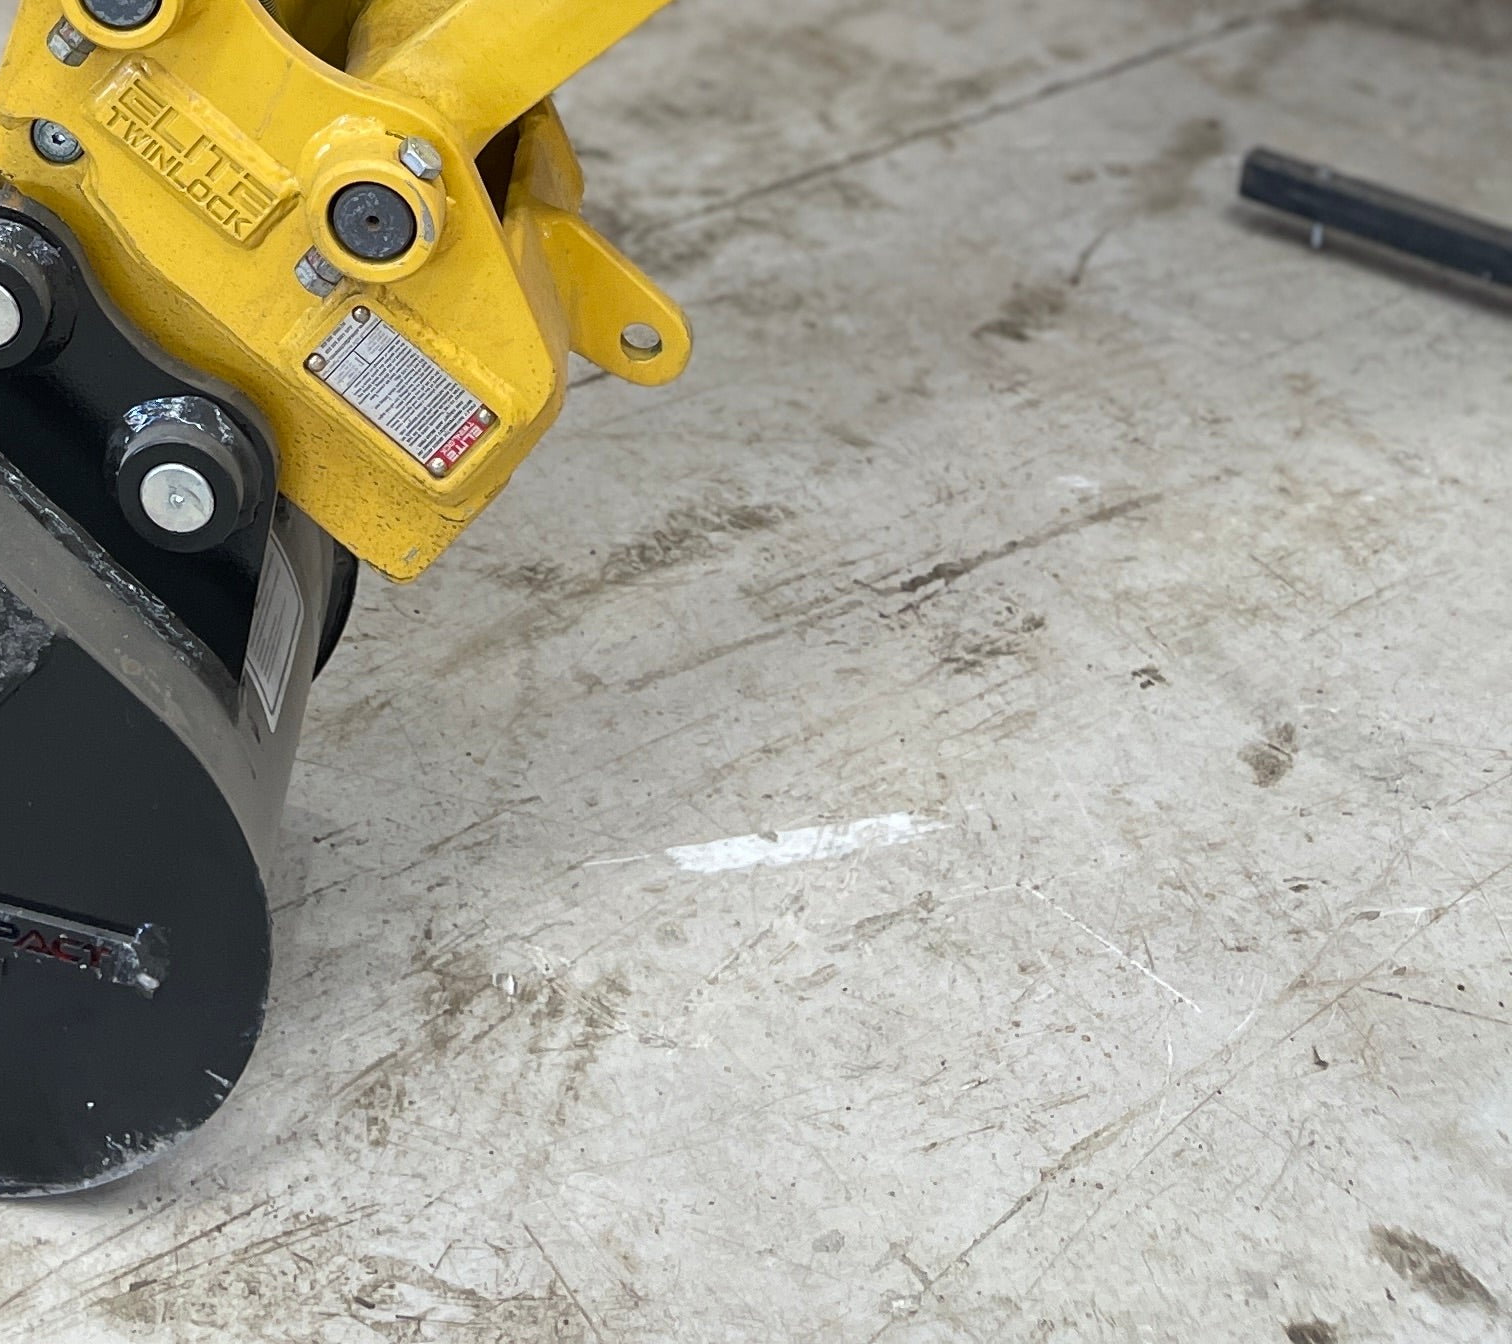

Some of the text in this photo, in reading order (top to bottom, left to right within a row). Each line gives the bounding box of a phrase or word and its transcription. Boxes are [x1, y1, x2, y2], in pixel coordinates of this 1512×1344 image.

[106, 105, 253, 240] TWINLOCK
[118, 77, 277, 211] ELITE
[441, 423, 487, 463] ELITE
